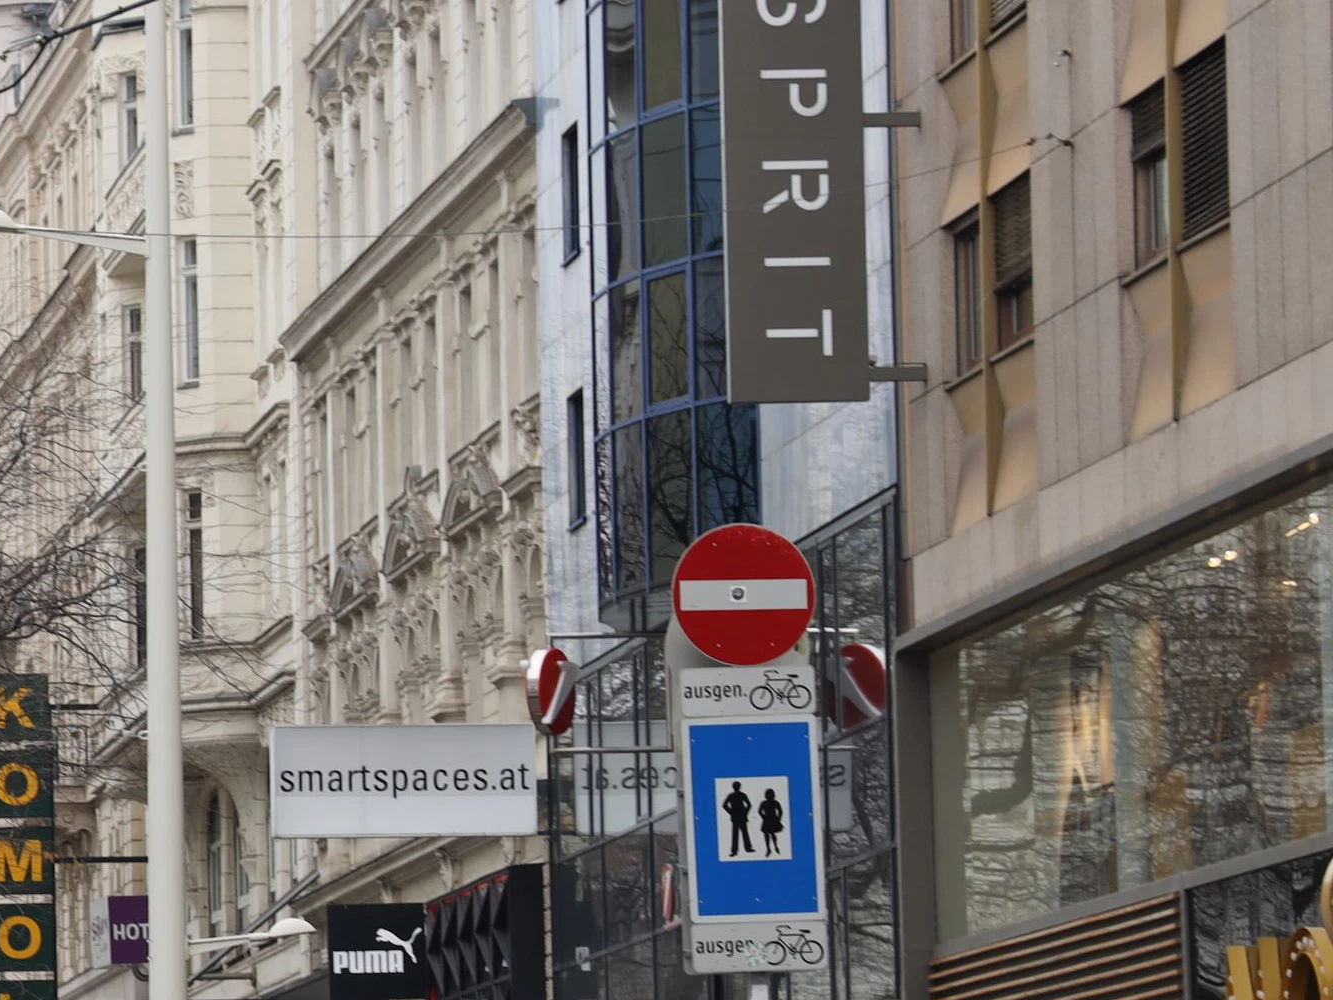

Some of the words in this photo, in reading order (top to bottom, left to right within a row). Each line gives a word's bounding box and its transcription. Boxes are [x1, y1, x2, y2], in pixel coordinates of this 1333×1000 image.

[684, 682, 747, 702] ausgen.
[279, 763, 530, 799] smartspaces.at
[113, 923, 149, 940] HOT
[333, 950, 405, 974] PUMA
